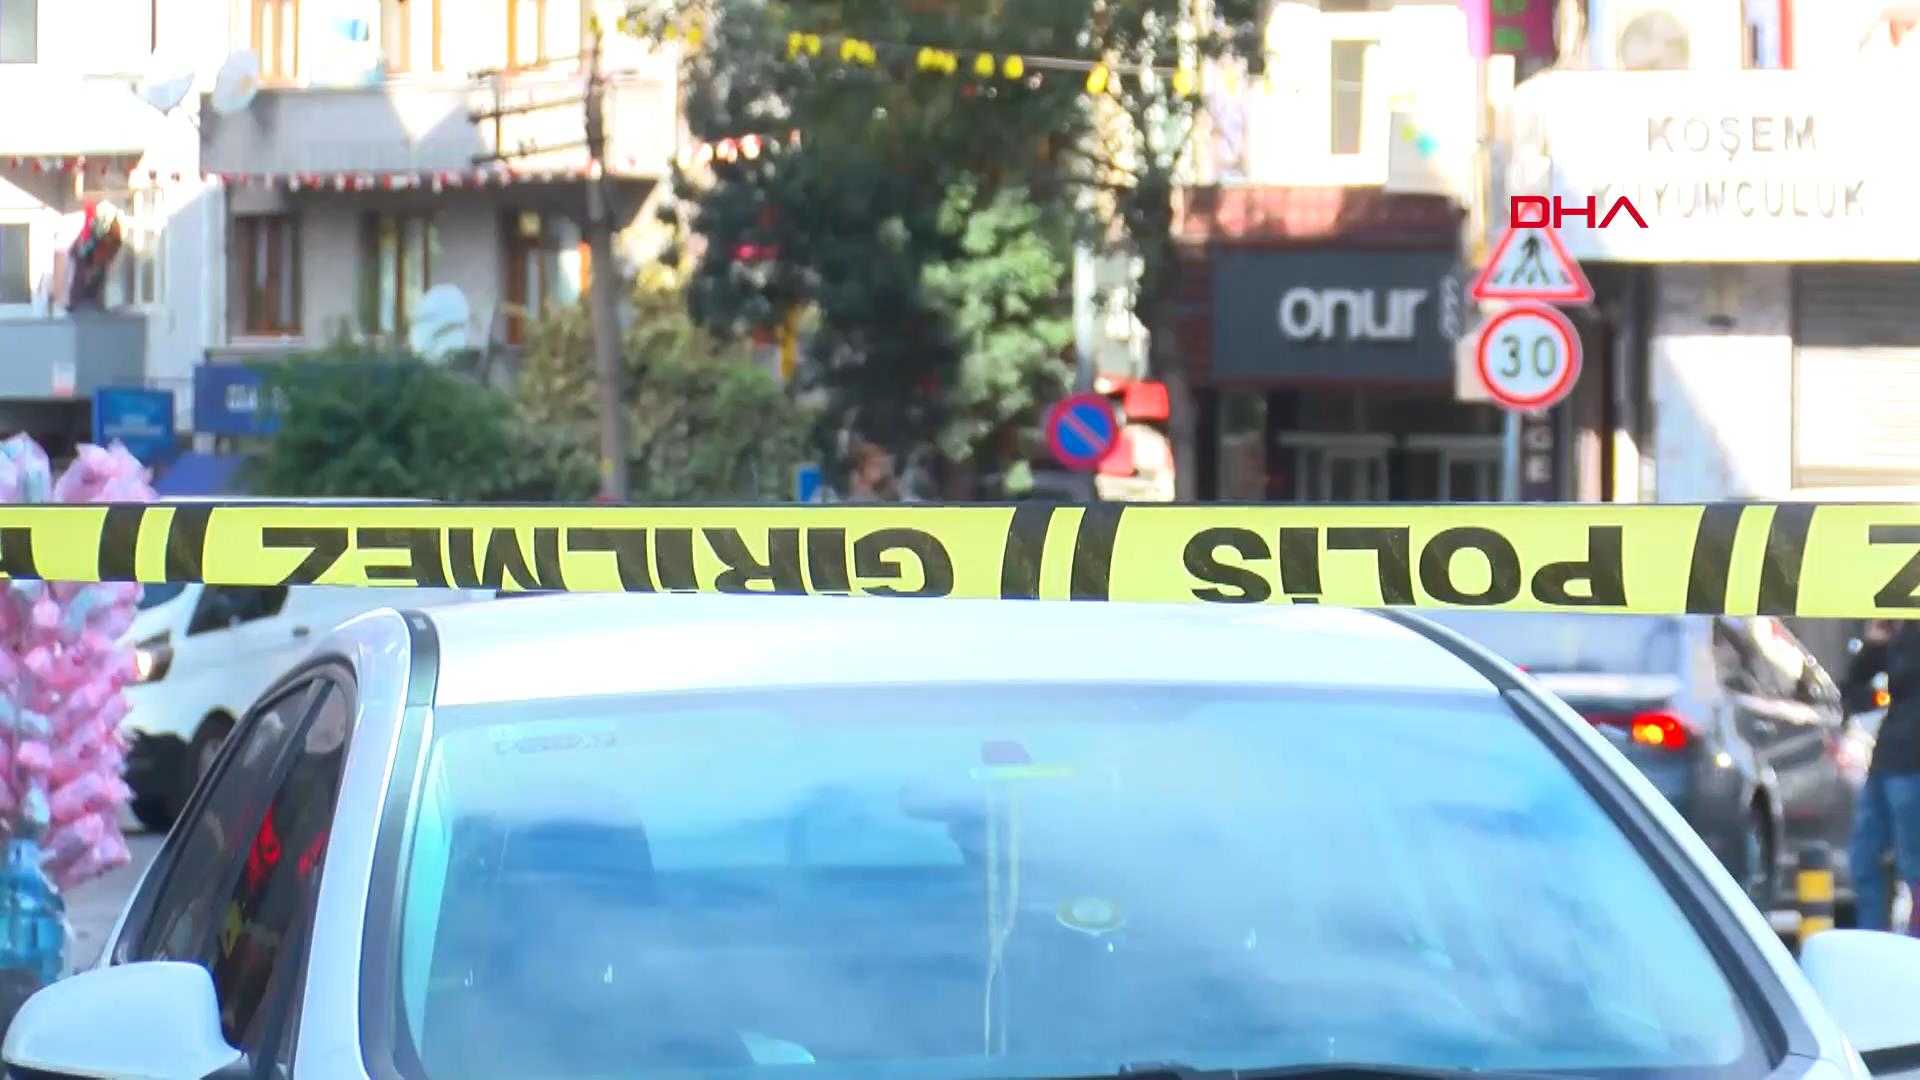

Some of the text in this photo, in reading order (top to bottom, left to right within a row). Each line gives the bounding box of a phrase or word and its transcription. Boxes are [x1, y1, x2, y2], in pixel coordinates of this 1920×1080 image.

[1646, 115, 1817, 161] KOŞEM
[1279, 287, 1427, 340] onur
[1500, 335, 1557, 378] 30
[1183, 526, 1628, 606] POLİS
